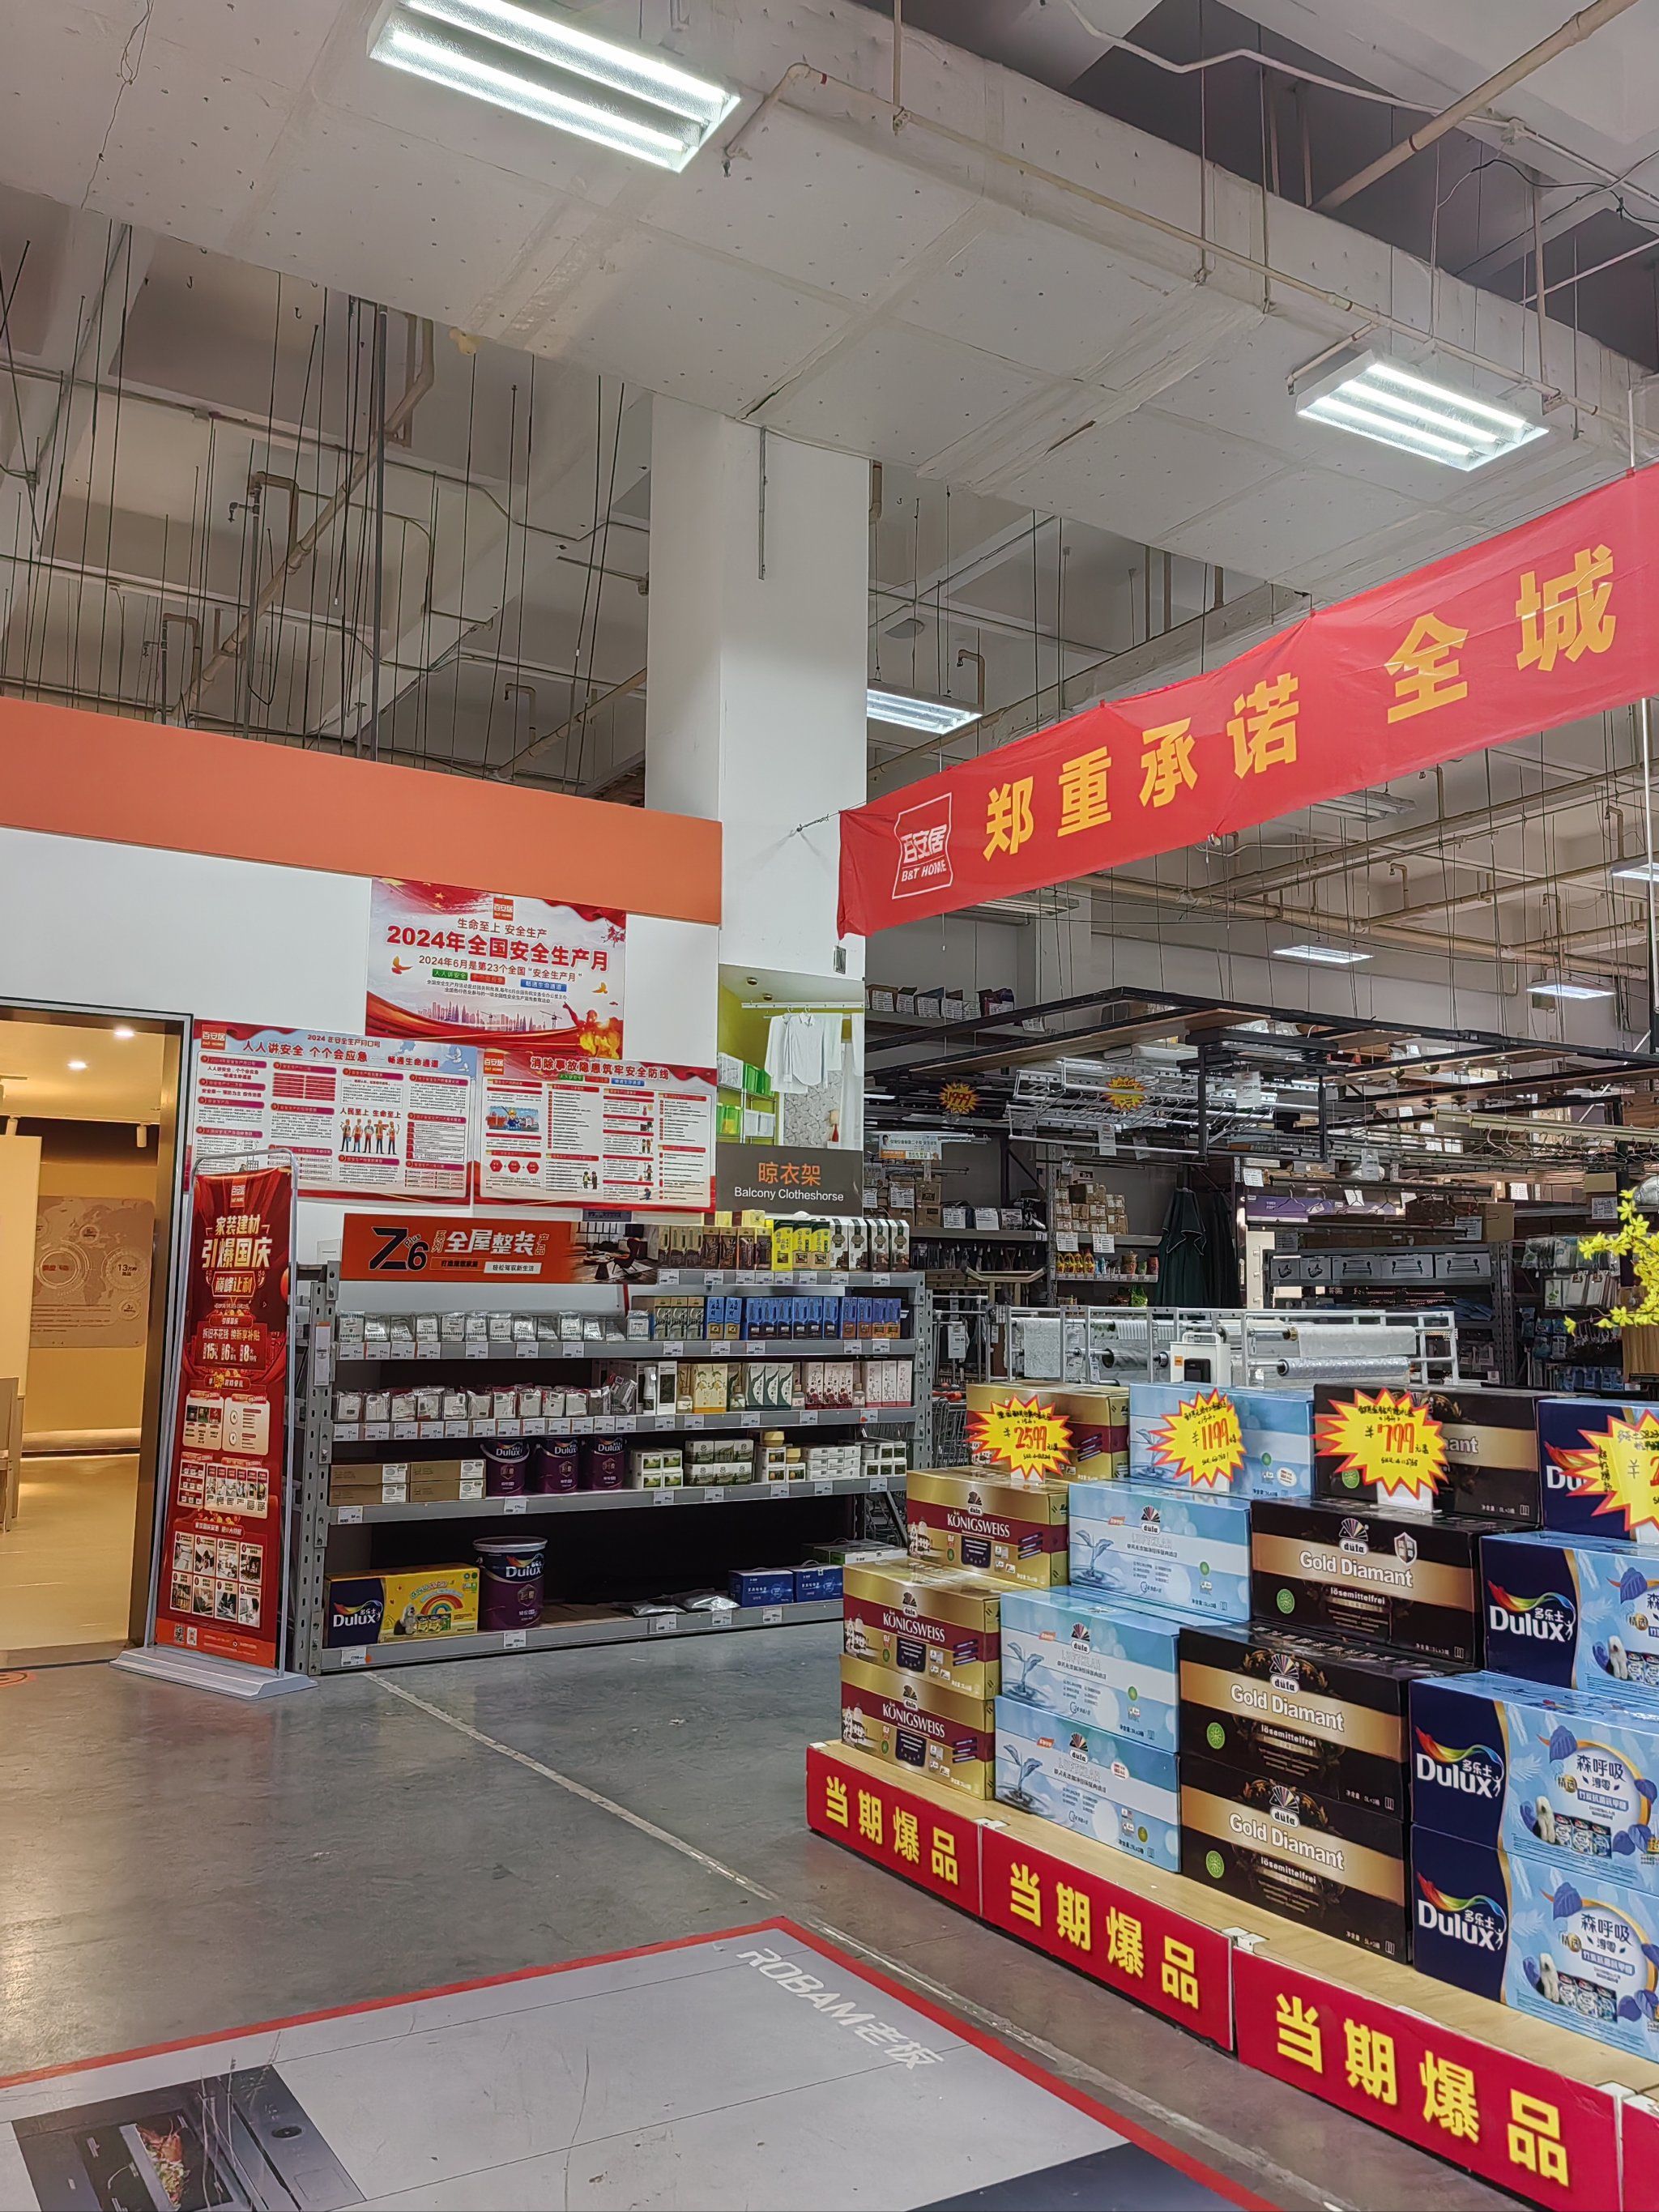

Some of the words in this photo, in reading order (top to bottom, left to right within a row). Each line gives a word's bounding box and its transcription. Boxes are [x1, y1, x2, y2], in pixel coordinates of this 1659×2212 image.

[983, 672, 1300, 862] 郑重承诺
[1384, 543, 1617, 723] 全城
[900, 824, 947, 864] 百安居
[902, 867, 919, 882] B&T
[921, 859, 947, 877] HOME
[457, 918, 501, 933] 生命至上
[505, 923, 548, 939] 安全生产
[386, 925, 609, 972] 2024年全国安全生产月
[243, 1041, 303, 1056] 人人讲安全
[309, 1046, 368, 1063] 个个会应急
[531, 1056, 670, 1080] 消除事故隐患筑牢安全防线
[340, 1107, 369, 1116] 人民至上
[373, 1110, 401, 1119] 生命至上
[757, 1161, 821, 1187] 晾衣架
[734, 1187, 776, 1200] Balcony
[778, 1189, 844, 1202] Clotheshorse
[215, 1214, 261, 1236] 家装建材
[202, 1236, 272, 1268] 引爆国庆
[445, 1229, 536, 1256] 全屋整装
[535, 1233, 550, 1255] 产品
[496, 1447, 521, 1456] Dulux
[554, 1446, 577, 1455] Dulux
[598, 1443, 621, 1451] Dulux
[947, 1510, 1010, 1538] KÖNIGSWEISS
[1344, 1543, 1364, 1553] düfa
[505, 1566, 541, 1578] Dulux
[1299, 1550, 1337, 1574] Gold
[1341, 1556, 1414, 1588] Diamant
[1330, 1587, 1385, 1605] lösemittelfrei
[333, 1613, 377, 1627] Dulux
[883, 1610, 945, 1643] KÖNIGSWEISS
[1489, 1605, 1566, 1643] Dulux
[1534, 1607, 1564, 1622] 多乐士
[1274, 1678, 1295, 1692] düfa
[882, 1703, 945, 1738] KÖNIGSWEISS
[1230, 1684, 1268, 1711] Gold
[1272, 1696, 1345, 1733] Diamant
[1261, 1724, 1316, 1748] lösemittelfrei
[1416, 1752, 1493, 1799] Dulux
[1462, 1758, 1492, 1777] 多乐士
[1576, 1754, 1627, 1783] 森呼吸
[825, 1775, 959, 1886] 当期爆品
[1274, 1812, 1295, 1825] düfa
[1230, 1813, 1267, 1843] Gold
[1272, 1827, 1345, 1870] Diamant
[1261, 1857, 1316, 1884] lösemittelfrei
[1418, 1899, 1495, 1951] Dulux
[1464, 1909, 1495, 1929] 多乐士
[1580, 1913, 1632, 1946] 森呼吸
[1010, 1862, 1199, 2010] 当期爆品
[1276, 1993, 1570, 2188] 当期爆品
